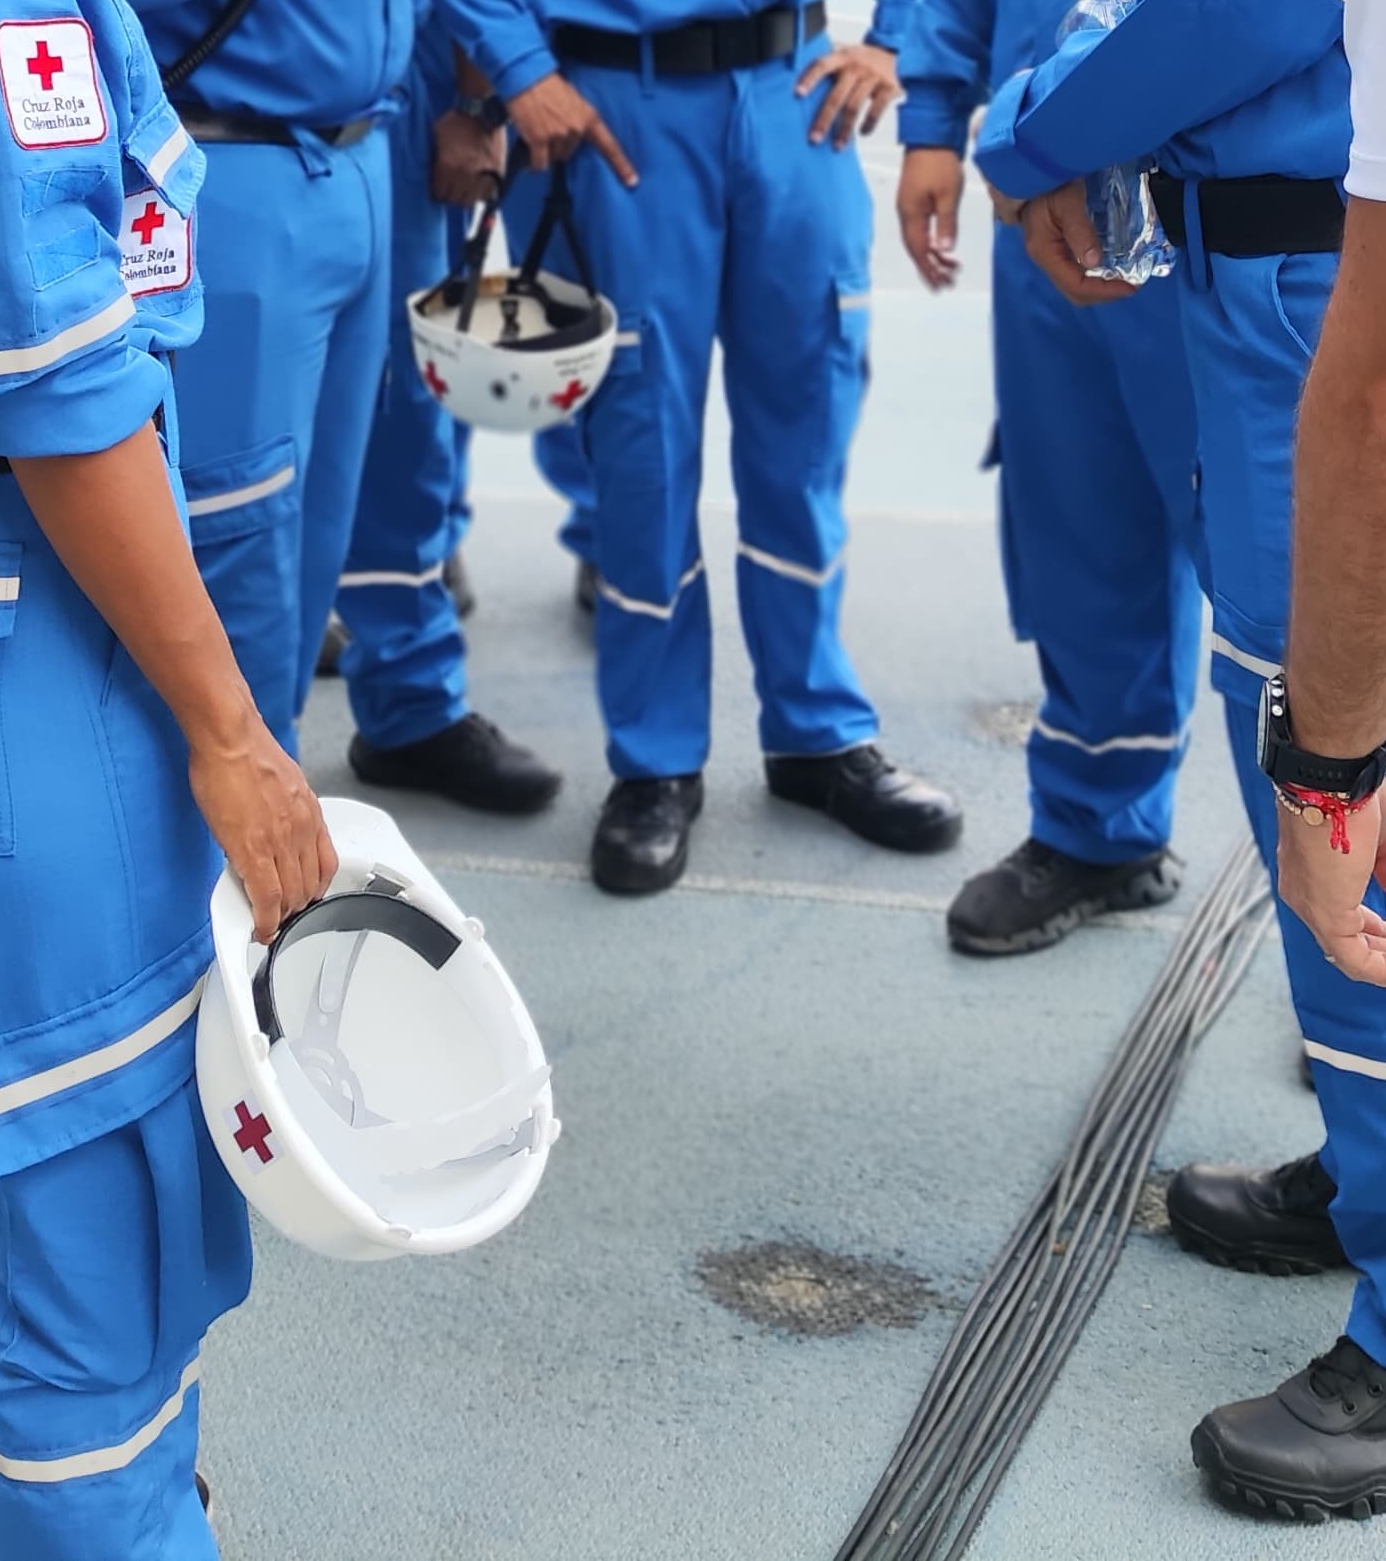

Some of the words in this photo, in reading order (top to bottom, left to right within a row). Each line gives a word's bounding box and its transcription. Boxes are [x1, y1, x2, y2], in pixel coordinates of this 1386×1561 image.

[21, 98, 50, 113] Cruz
[53, 96, 85, 113] Roja
[23, 114, 92, 130] Colombiana
[147, 248, 175, 263] Roja
